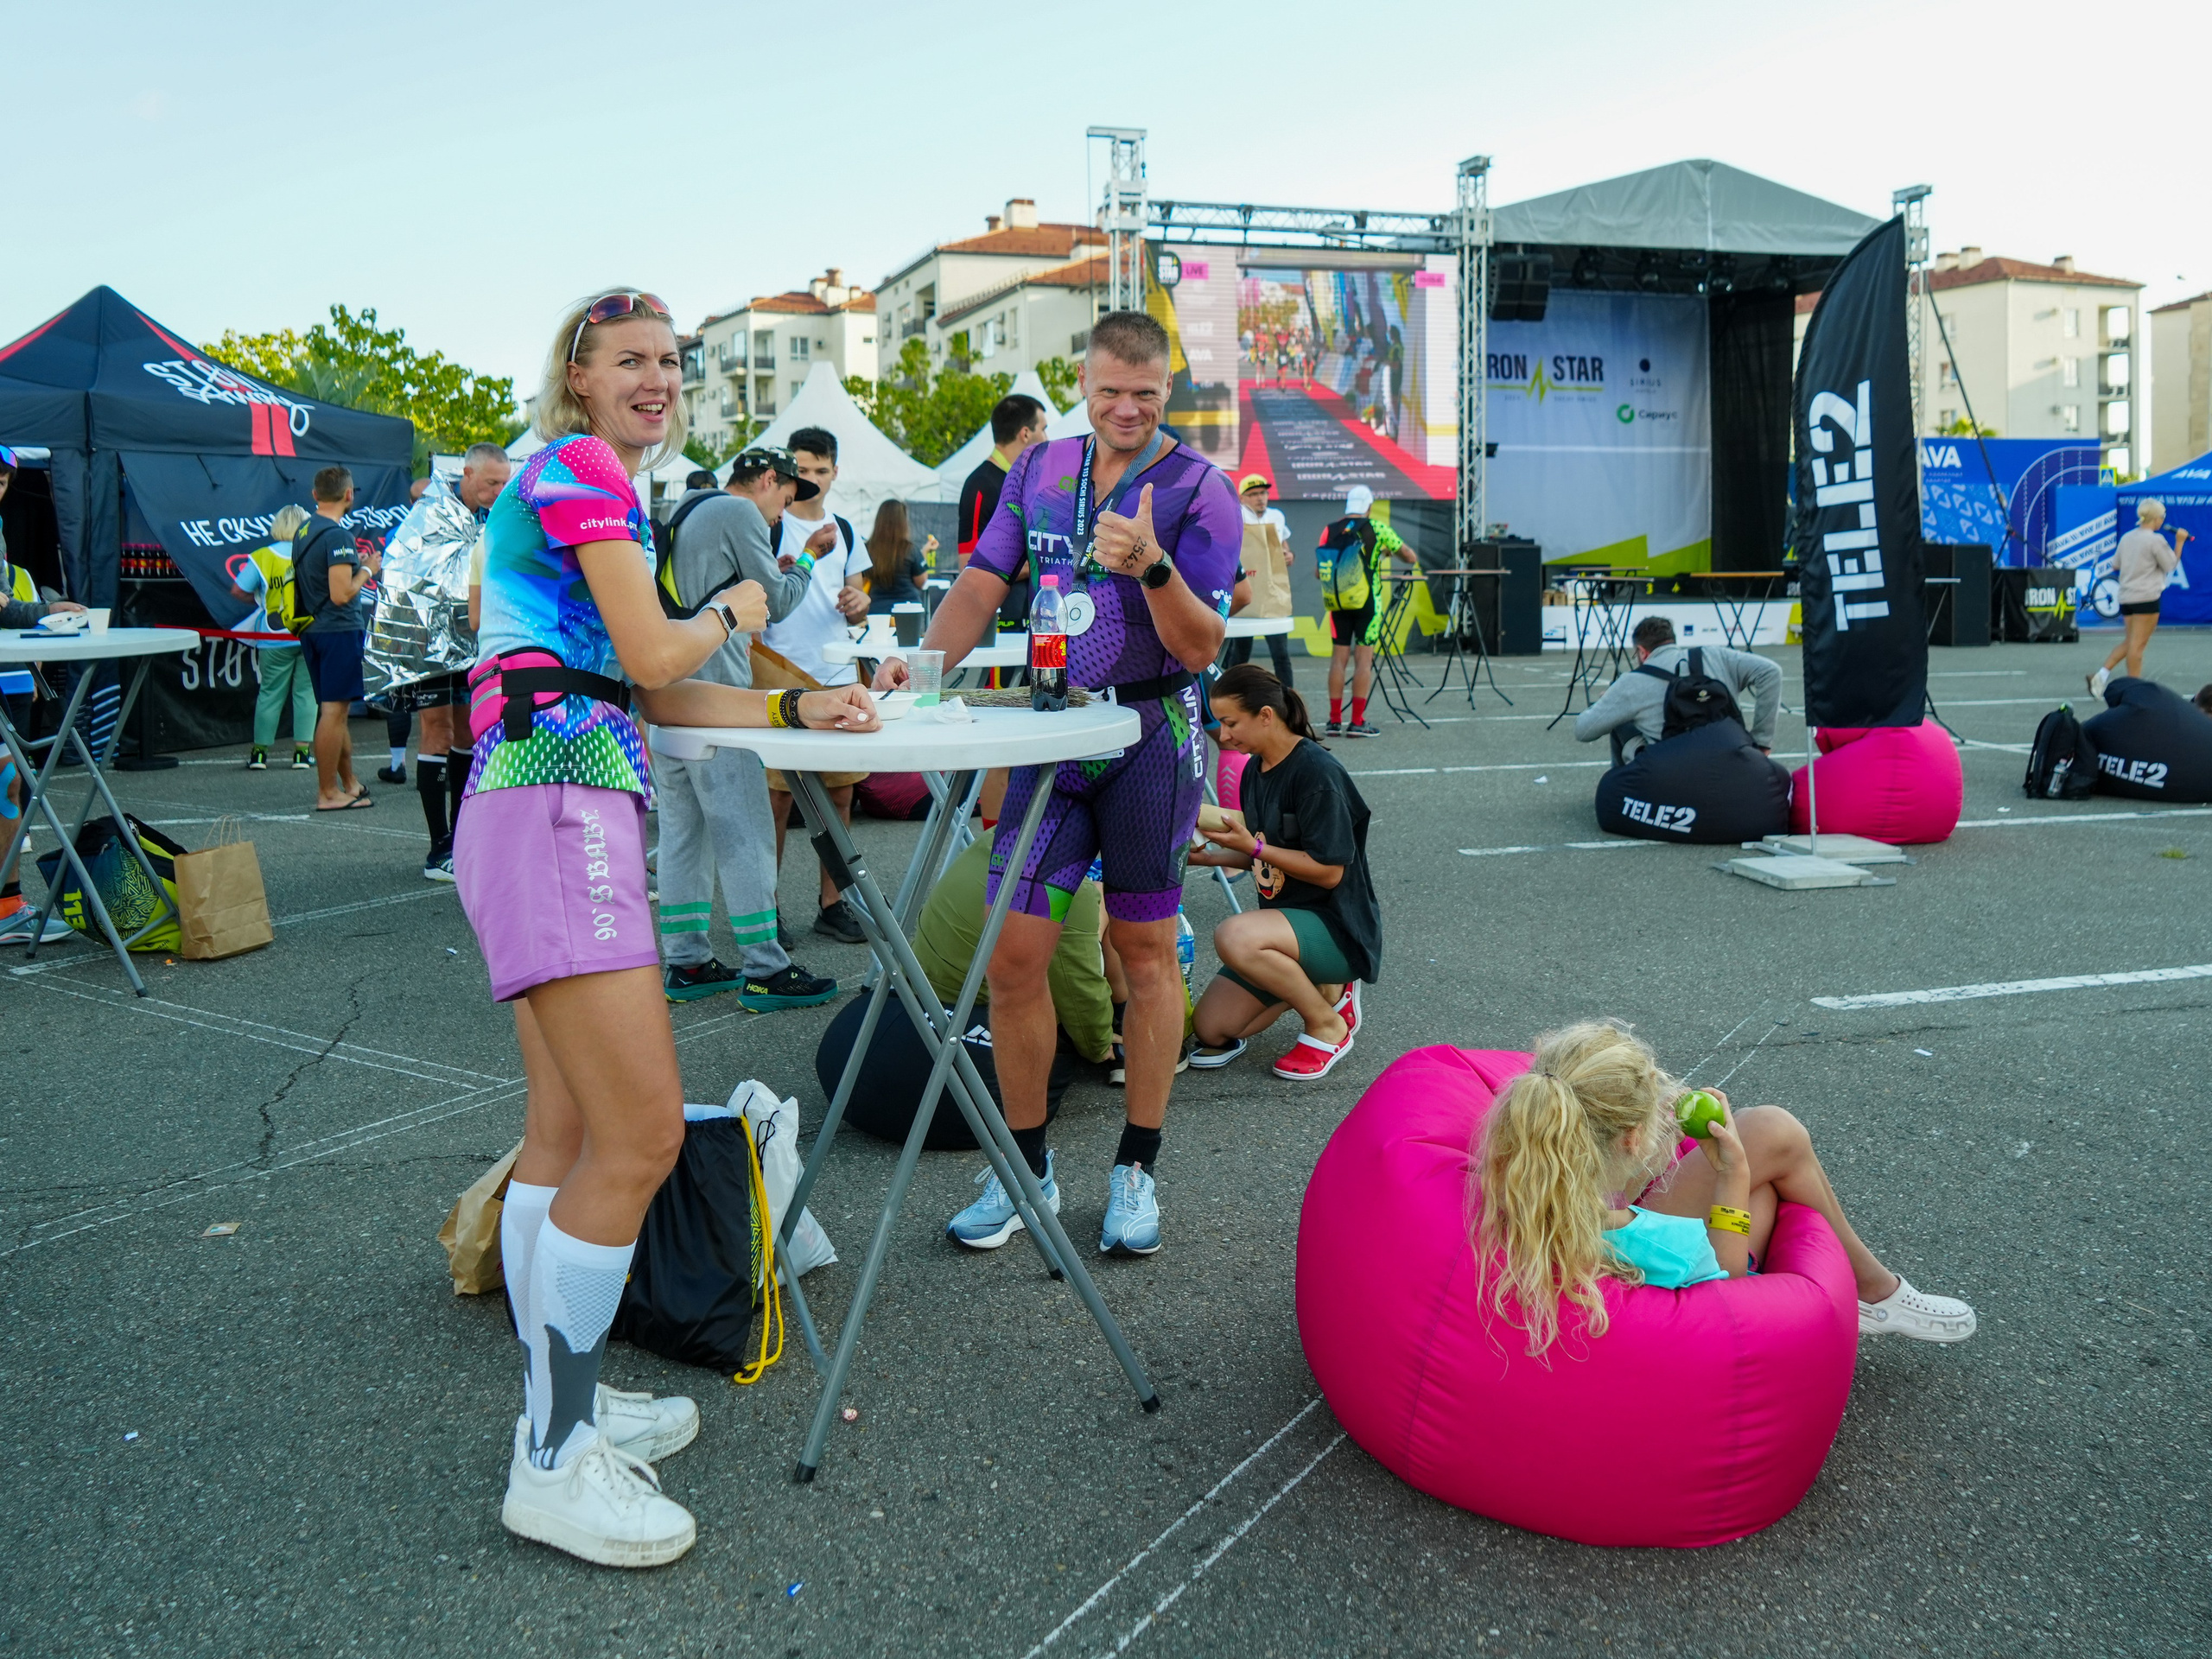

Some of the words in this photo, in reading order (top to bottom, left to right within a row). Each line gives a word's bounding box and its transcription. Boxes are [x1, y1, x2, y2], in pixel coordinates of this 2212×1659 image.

[1186, 266, 1204, 276] LIVE
[1486, 353, 1528, 380] RON
[1553, 355, 1605, 382] STAR
[1079, 479, 1088, 497] SOCHI
[1077, 498, 1086, 518] SIRIUS
[1808, 378, 1891, 632] TELE2
[180, 520, 224, 547] НЕ
[1122, 535, 1147, 569] 2542
[2024, 587, 2056, 607] IRON
[2066, 587, 2076, 606] ST
[1180, 685, 1204, 779] CITYLIN
[2097, 753, 2168, 789] TELE2
[1621, 796, 1697, 834] TELE2
[580, 809, 611, 881] BABY
[63, 887, 86, 930] 113
[746, 982, 769, 995] HOKA
